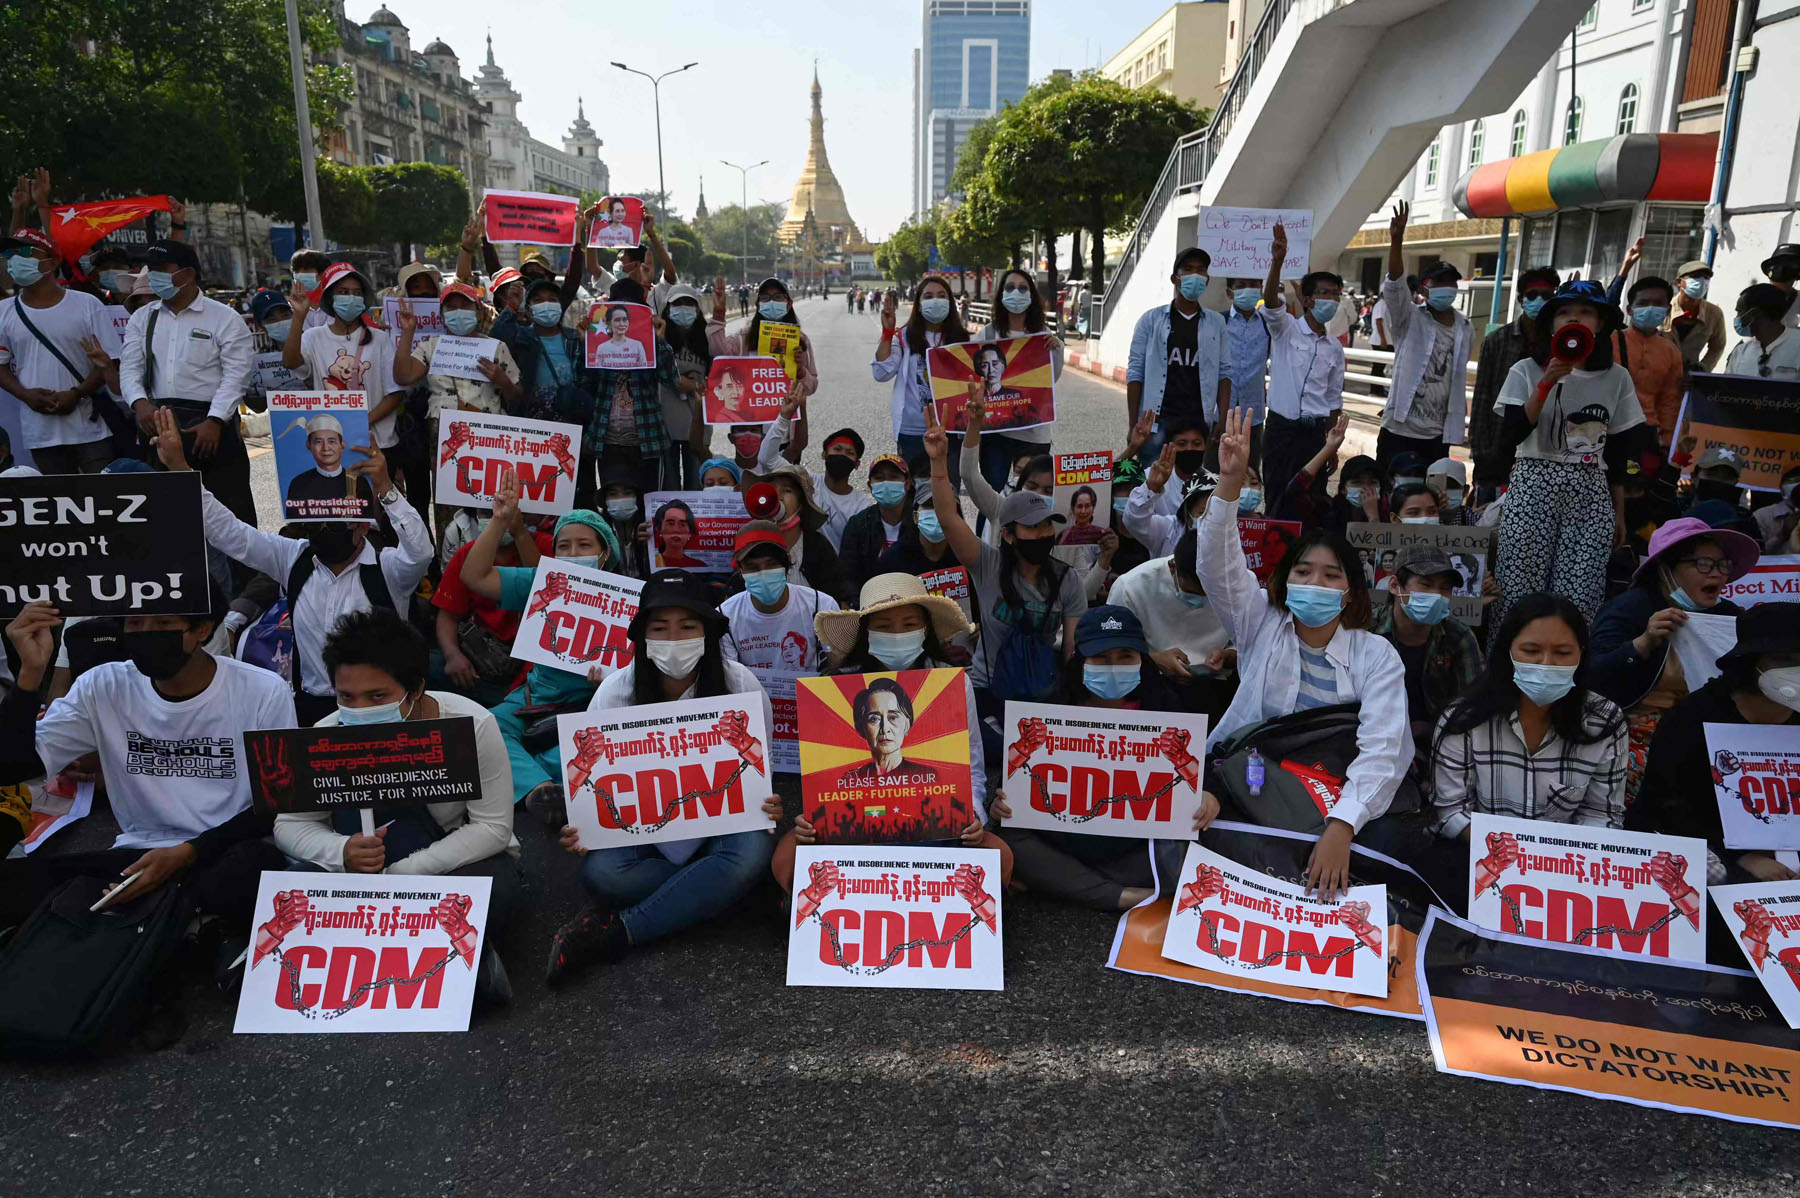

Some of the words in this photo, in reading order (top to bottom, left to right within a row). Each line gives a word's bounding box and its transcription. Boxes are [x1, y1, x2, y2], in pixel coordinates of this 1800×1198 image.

[1205, 213, 1230, 229] We
[1217, 238, 1256, 260] Military
[1212, 256, 1240, 268] SAVE
[455, 351, 474, 359] Military
[464, 364, 481, 373] Myan
[752, 368, 784, 378] FREE
[752, 382, 787, 394] OUR
[483, 423, 520, 432] DISOBEDIENCE
[521, 428, 551, 436] MOVEMENT
[1754, 447, 1785, 460] NOT
[456, 455, 558, 502] CDM
[1057, 471, 1089, 485] CDM
[285, 499, 305, 507] Our
[308, 498, 368, 507] President's
[332, 507, 362, 516] Myint
[712, 521, 745, 529] Governme
[1246, 520, 1266, 530] Want
[20, 535, 109, 557] won't
[699, 538, 717, 546] not
[1350, 530, 1374, 545] We
[1376, 531, 1392, 545] all
[1436, 535, 1460, 548] the
[1464, 536, 1489, 549] One
[87, 573, 183, 609] Up!
[567, 574, 581, 583] CIVIL
[583, 578, 621, 592] DISOBEDIENCE
[1720, 580, 1765, 598] eject
[739, 637, 750, 645] WE
[751, 635, 769, 643] WANT
[740, 644, 754, 652] OUR
[755, 642, 781, 650] LEADER
[601, 723, 619, 732] CIVIL
[622, 717, 675, 730] DISOBEDIENCE
[676, 711, 719, 723] MOVEMENT
[1045, 718, 1063, 726] CIVIL
[1065, 719, 1116, 730] DISOBEDIENCE
[1118, 724, 1162, 733] MOVEMENT
[128, 741, 234, 758] BEGHOULS
[127, 753, 236, 771] BEGHOULS
[313, 776, 346, 788] CIVIL
[352, 769, 448, 786] DISOBEDIENCE
[837, 777, 874, 789] PLEASE
[878, 775, 909, 786] SAVE
[912, 773, 936, 784] OUR
[316, 790, 372, 804] JUSTICE
[379, 788, 405, 800] FOR
[412, 782, 473, 798] MYANMAR
[595, 759, 745, 829] CDM
[818, 790, 863, 802] LEADER
[870, 787, 916, 799] FUTURE
[924, 784, 956, 796] HOPE
[1030, 763, 1173, 822] CDM
[1515, 833, 1536, 843] CIVIL
[1539, 836, 1599, 850] DISOBEDIENCE
[1601, 843, 1652, 857] MOVEMENT
[837, 860, 855, 868] CIVIL
[858, 860, 910, 869] DISOBEDIENCE
[912, 861, 955, 870] MOVEMENT
[1223, 871, 1241, 883] CIVIL
[1242, 879, 1293, 900] DISOBEDIENCE
[307, 889, 329, 898] CIVIL
[331, 889, 391, 899] DISOBEDIENCE
[393, 891, 442, 901] MOVEMENT
[1758, 897, 1778, 905] CIVIL
[1500, 884, 1669, 957] CDM
[819, 908, 971, 969] CDM
[1196, 909, 1354, 978] CDM
[275, 945, 449, 1011] CDM
[1496, 1024, 1548, 1046] WE
[1554, 1034, 1601, 1054] DO
[1610, 1042, 1677, 1066] NOT
[1687, 1055, 1791, 1085] WANT
[1521, 1047, 1791, 1103] DICTATORSHIP!
